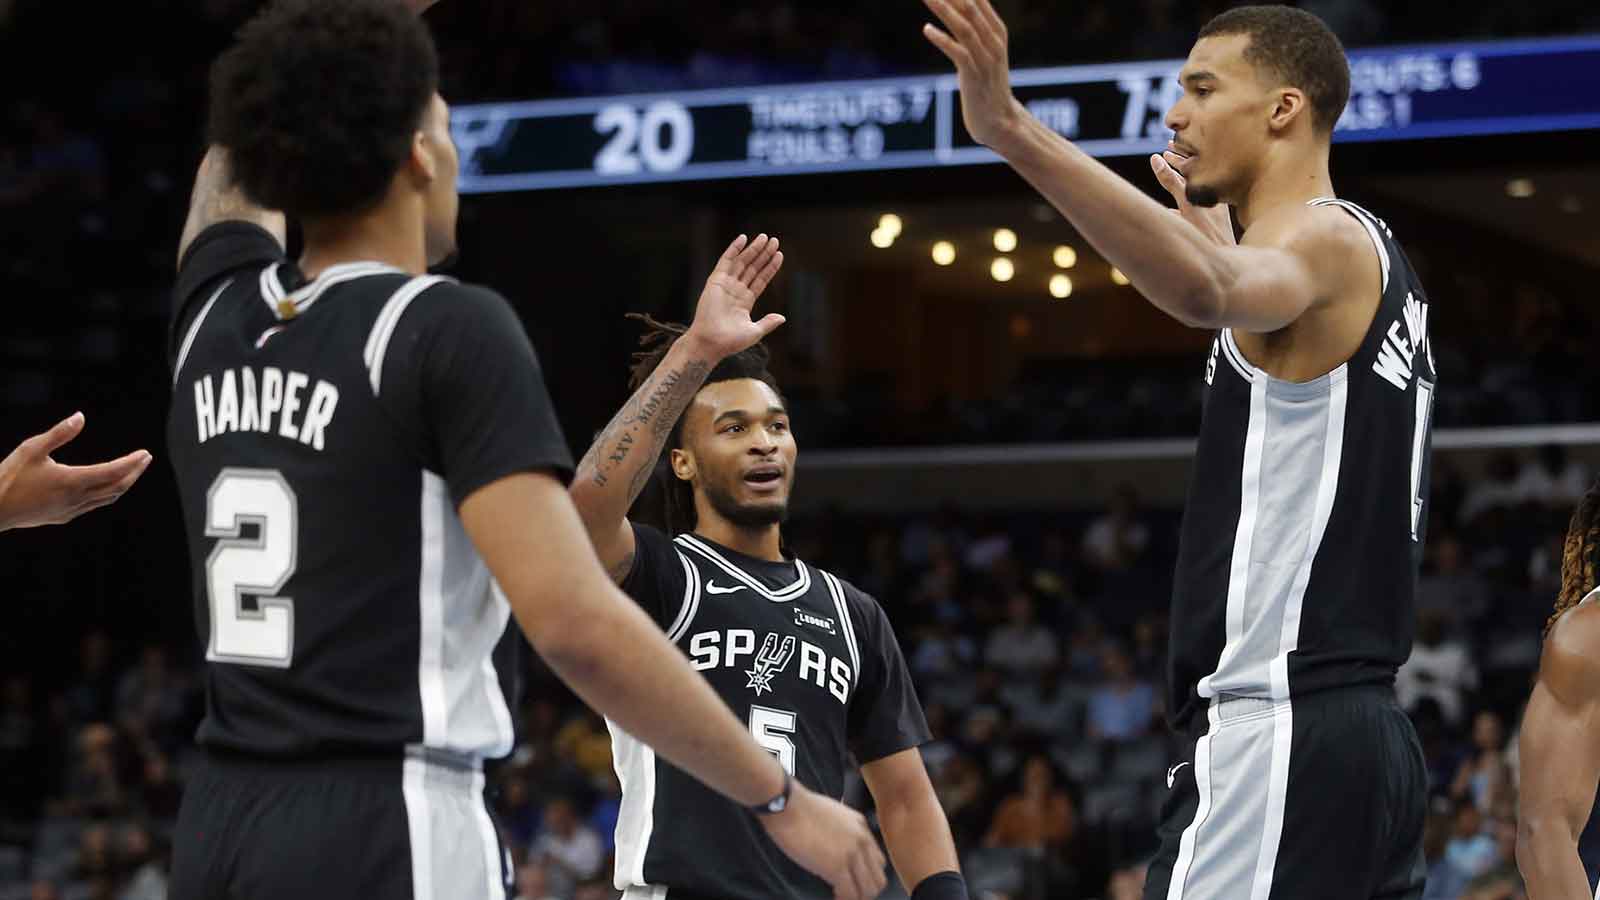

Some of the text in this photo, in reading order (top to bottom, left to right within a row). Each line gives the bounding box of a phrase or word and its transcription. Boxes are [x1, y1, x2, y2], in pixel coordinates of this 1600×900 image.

[593, 101, 695, 174] 20
[193, 366, 340, 451] HARPER
[204, 467, 299, 669] 2
[689, 628, 851, 705] SPURS
[748, 703, 798, 777] 5
